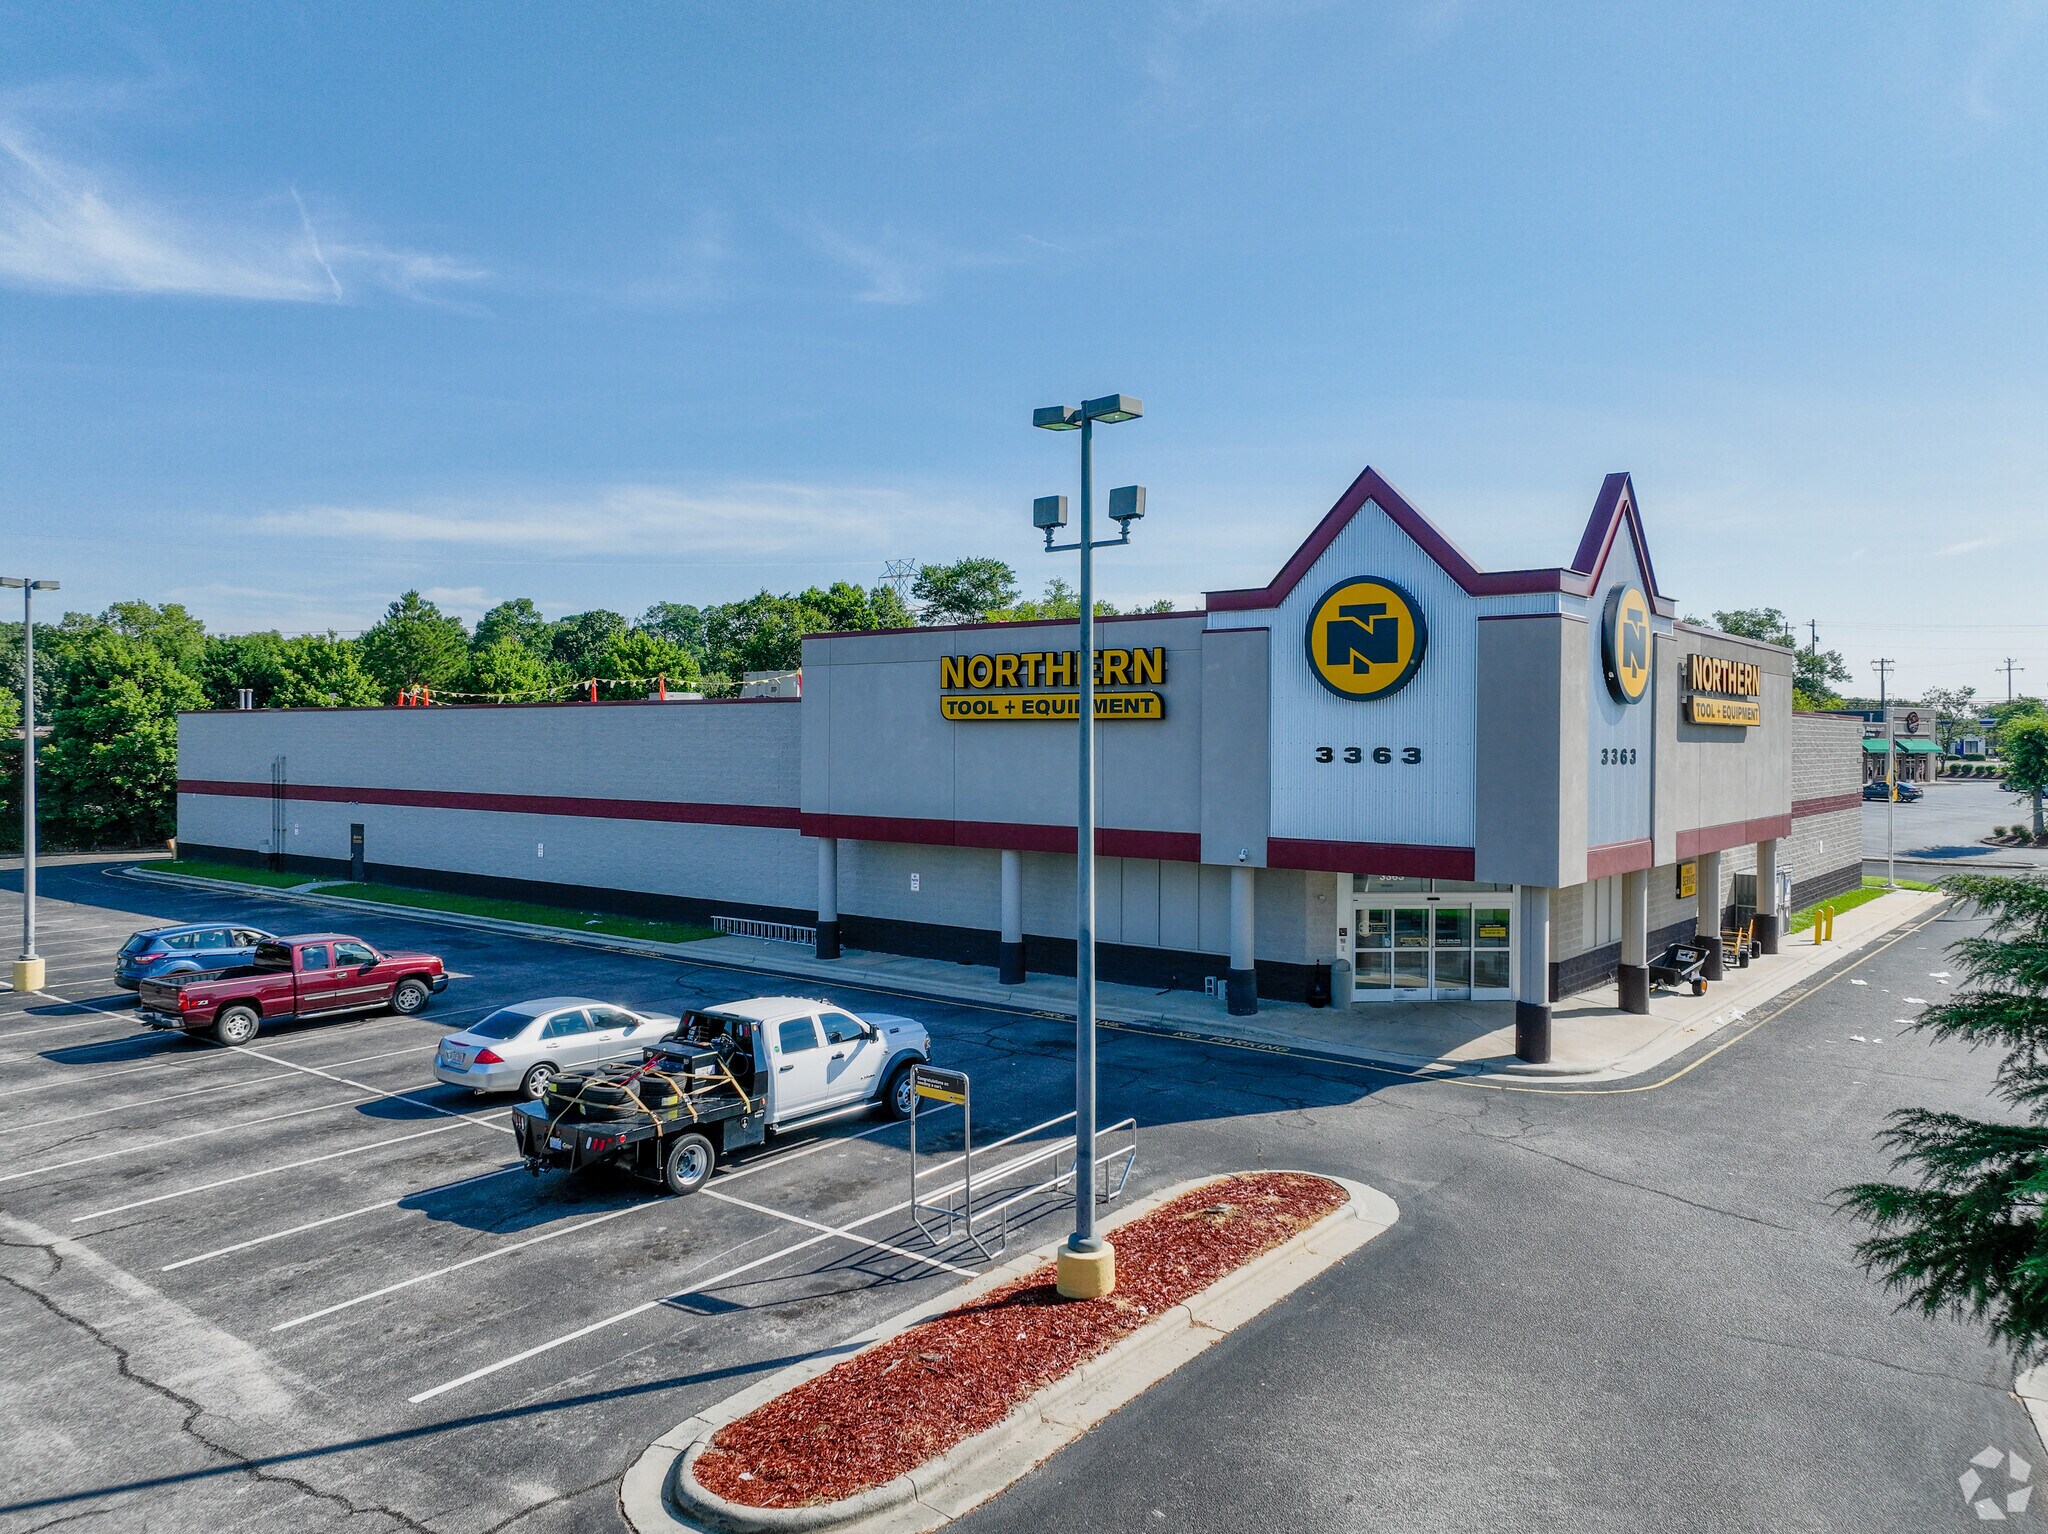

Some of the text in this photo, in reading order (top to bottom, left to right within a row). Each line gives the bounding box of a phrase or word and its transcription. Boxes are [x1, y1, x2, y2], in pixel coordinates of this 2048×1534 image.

[1693, 655, 1760, 696] NORTHERN
[947, 700, 998, 715] TOOL
[1696, 703, 1715, 718] TOOL
[1722, 705, 1759, 721] EQUIPMENT
[1315, 747, 1422, 764] 3363
[1601, 748, 1637, 766] 3363
[1173, 1031, 1291, 1053] NO PARKING
